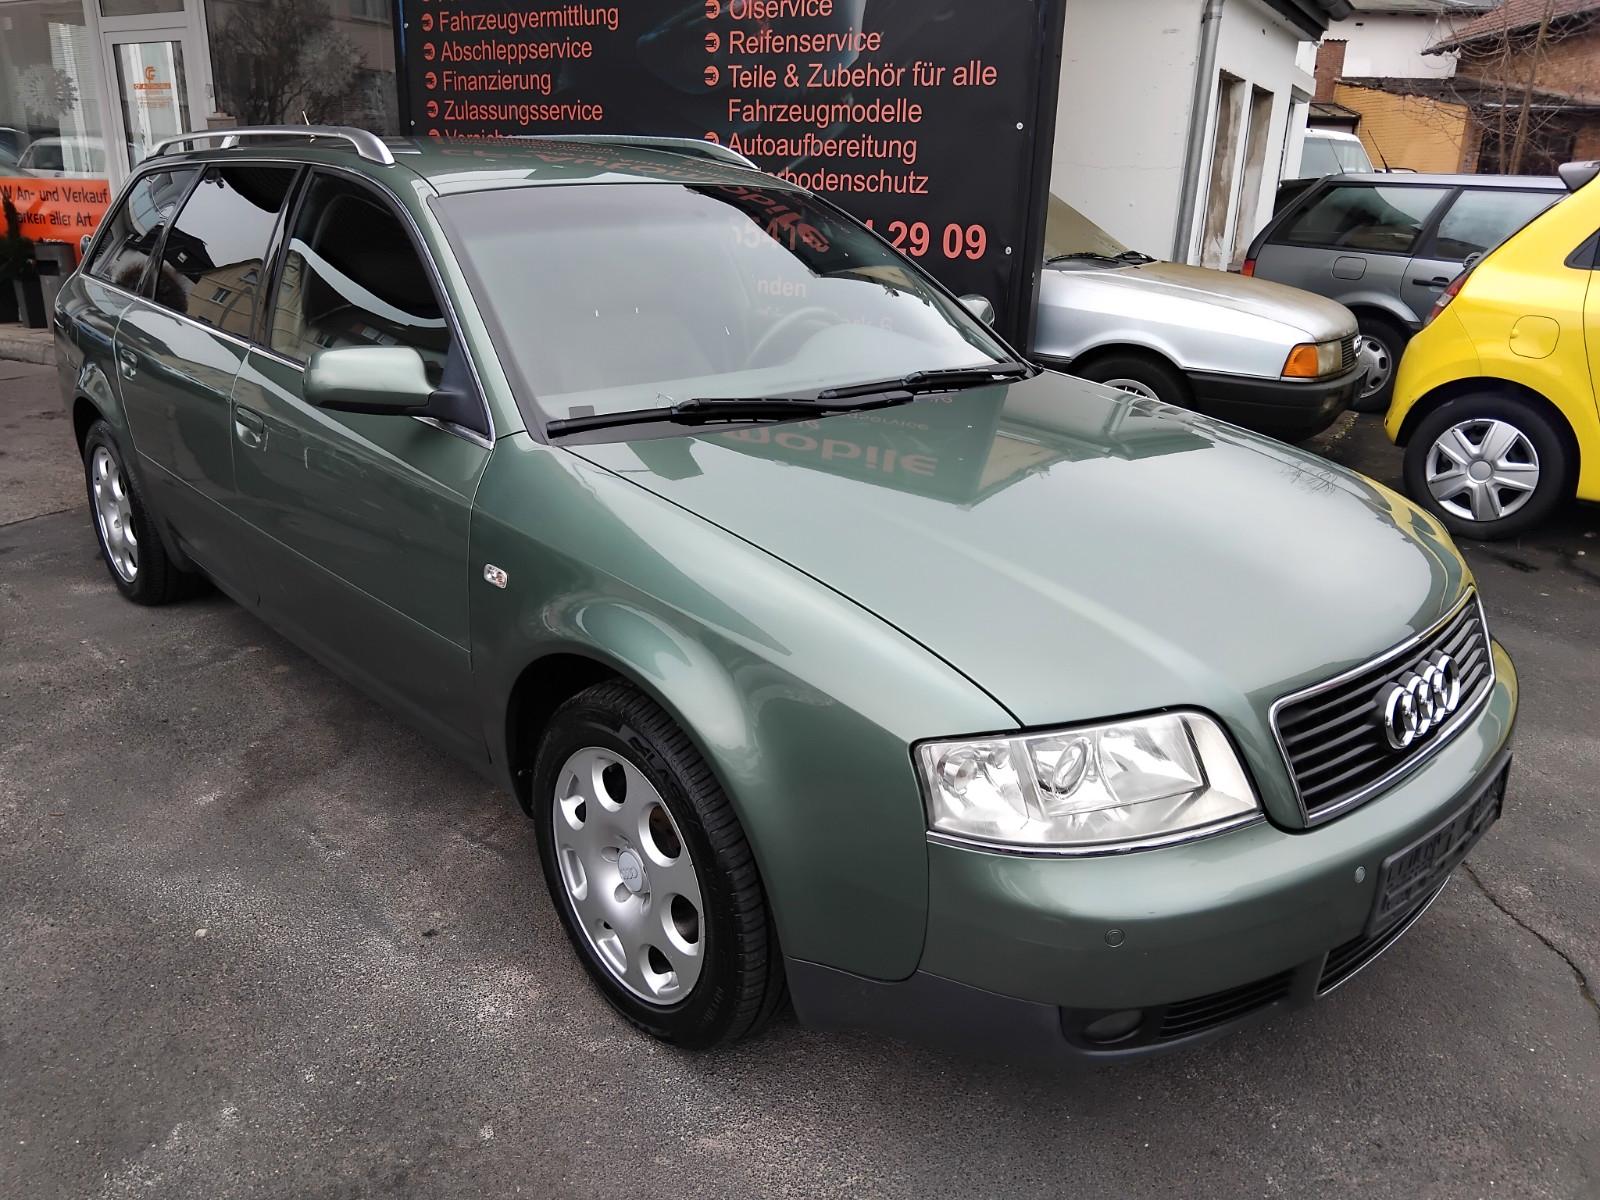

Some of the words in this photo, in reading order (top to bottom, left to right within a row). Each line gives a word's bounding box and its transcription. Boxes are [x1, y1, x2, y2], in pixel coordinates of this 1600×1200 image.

[438, 5, 619, 34] Fahrzeugvermittlung
[440, 38, 593, 64] Abschleppservice
[729, 27, 882, 54] Reifenservice
[442, 70, 552, 96] Finanzierung
[728, 64, 777, 88] Teile
[783, 64, 799, 88] &
[807, 63, 905, 88] Zubehör
[912, 62, 946, 87] für
[952, 60, 998, 86] alle
[443, 100, 604, 126] Zulassungsservice
[728, 98, 923, 128] Fahrzeugmodelle
[728, 132, 918, 164] Autoaufbereitung
[40, 187, 59, 202] und
[62, 186, 108, 204] Verkauf
[16, 211, 46, 225] arken
[49, 212, 71, 226] aller
[76, 212, 93, 226] Art
[888, 220, 930, 257] 29
[943, 223, 987, 260] 09
